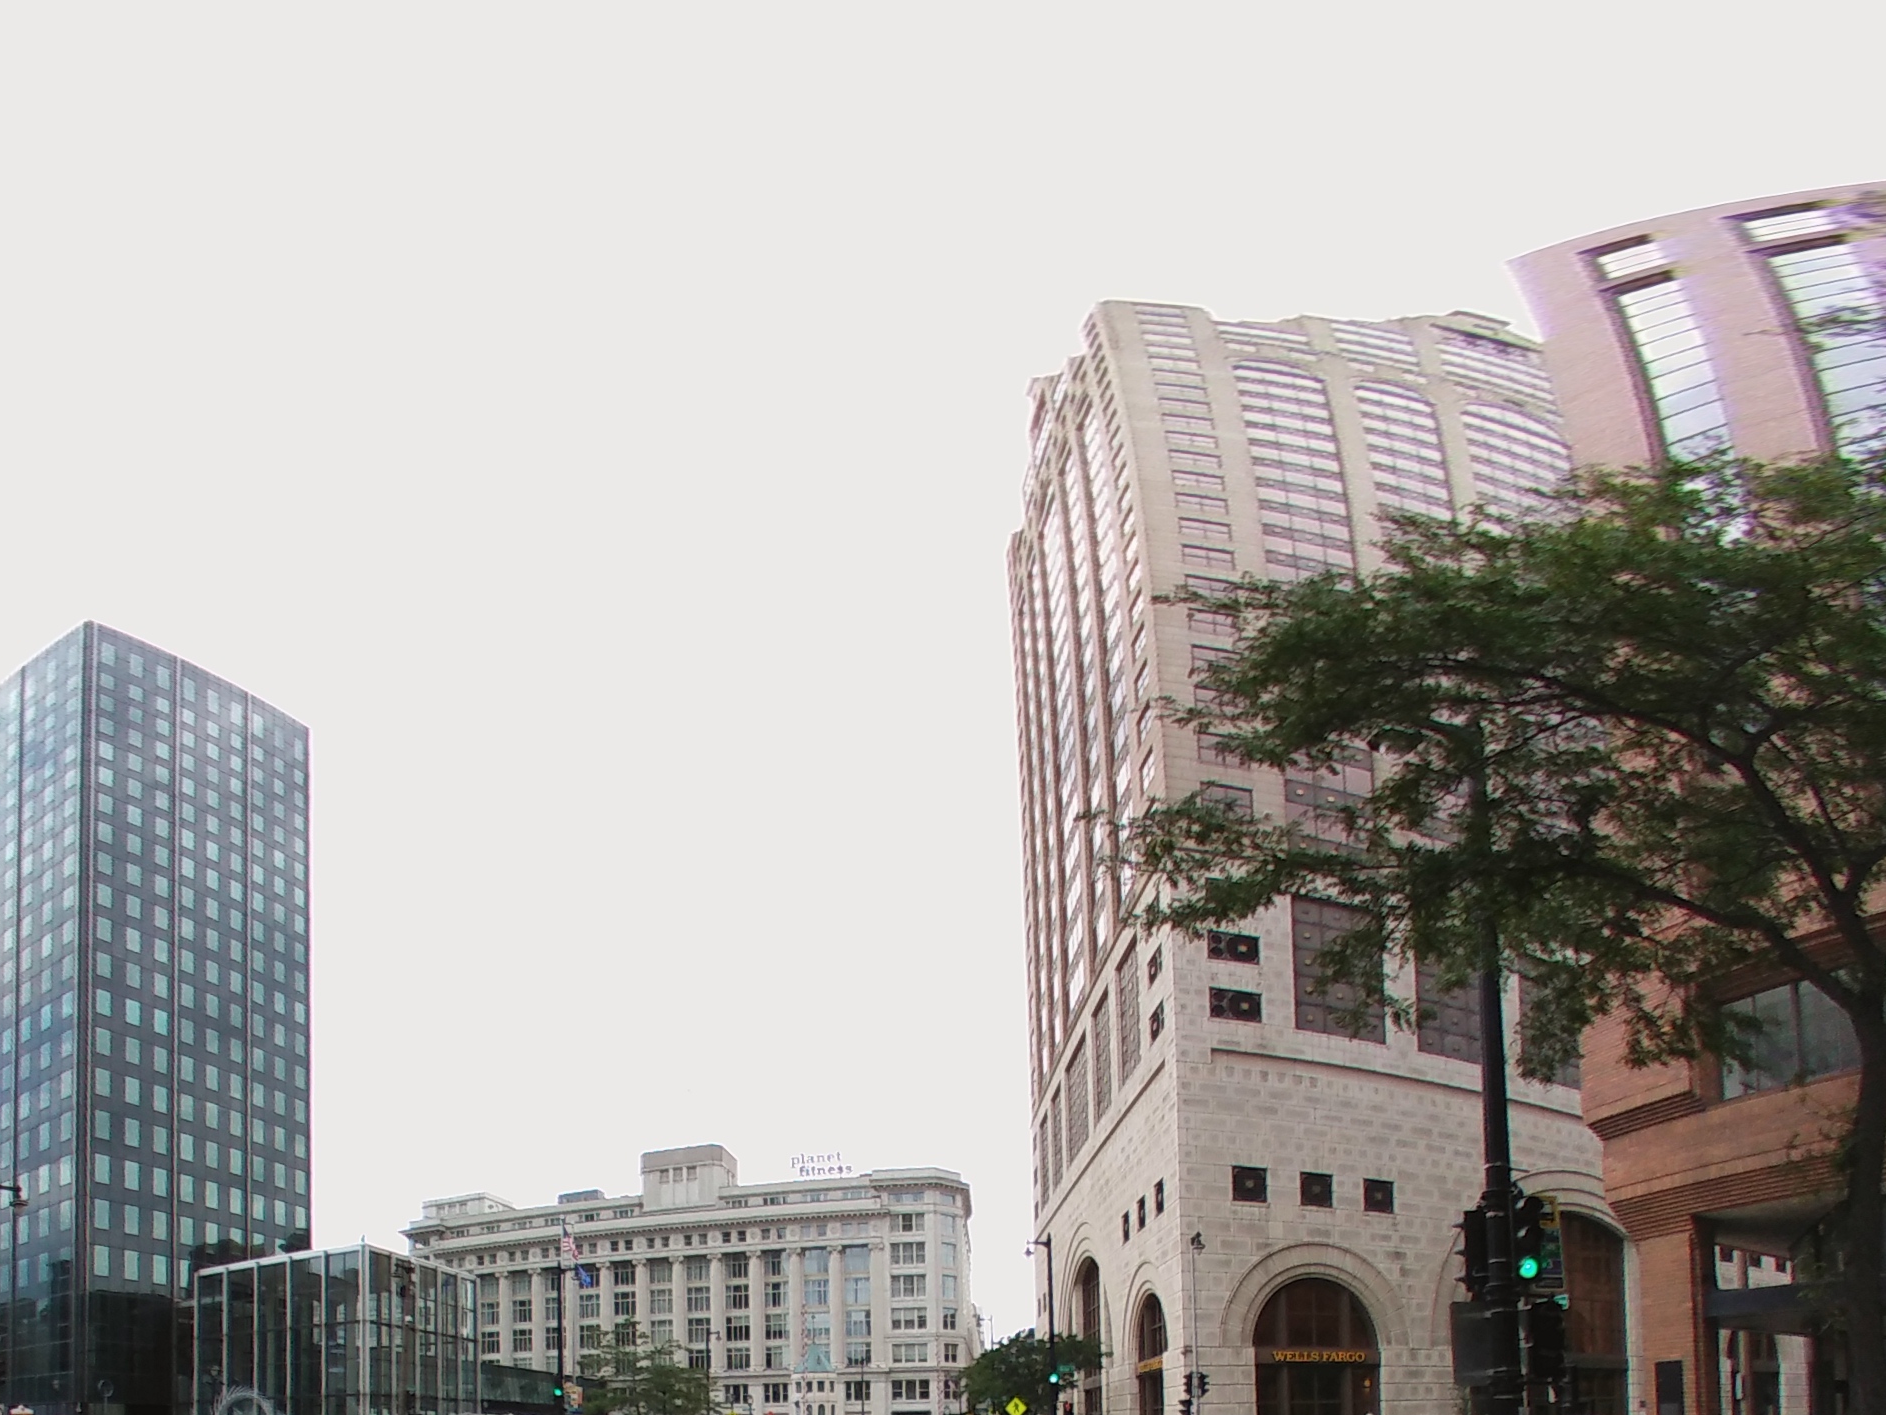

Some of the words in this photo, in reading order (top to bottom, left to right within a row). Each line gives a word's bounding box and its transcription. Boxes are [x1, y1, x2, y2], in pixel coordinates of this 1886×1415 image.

[791, 1152, 841, 1169] planet
[799, 1165, 853, 1177] fitness
[1273, 1351, 1320, 1362] WELLS
[1322, 1351, 1365, 1362] FARGO
